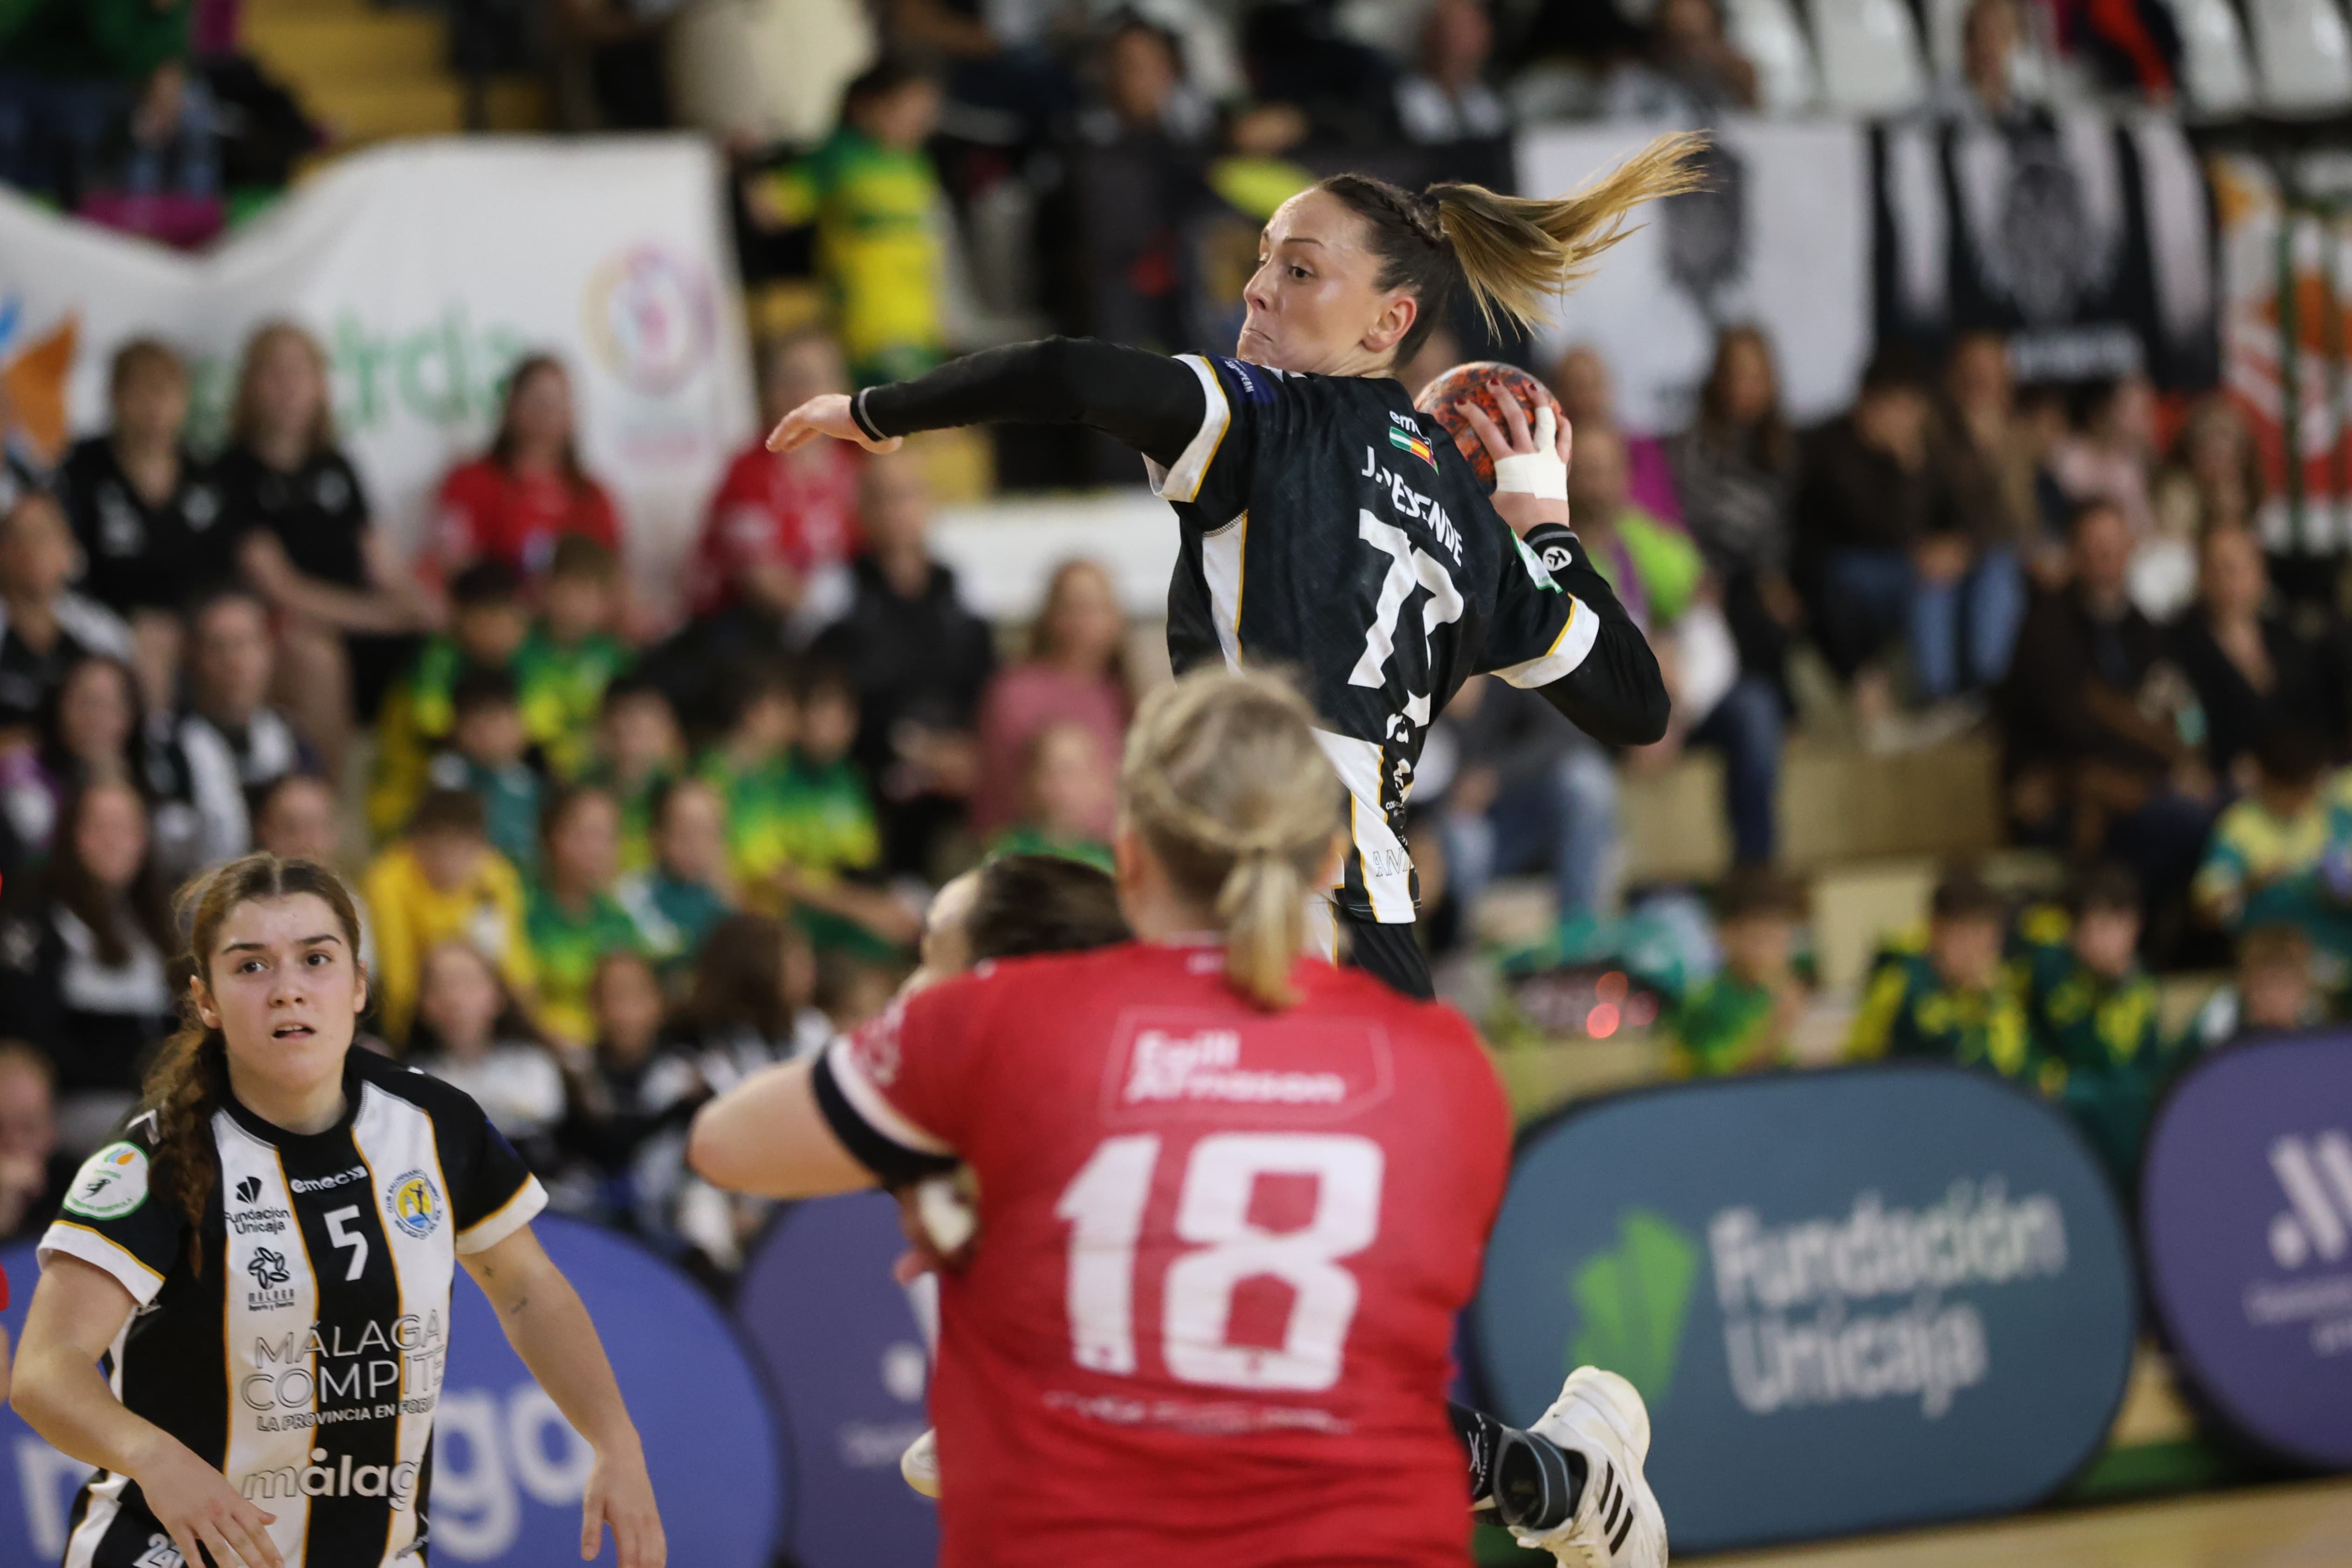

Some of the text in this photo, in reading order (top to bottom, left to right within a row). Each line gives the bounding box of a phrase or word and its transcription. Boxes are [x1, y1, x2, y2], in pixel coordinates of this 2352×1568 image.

[323, 1204, 369, 1281] 5
[1052, 1131, 1386, 1394] 18
[1709, 1174, 2068, 1305] Fundación
[255, 1308, 441, 1369] MÁLAGA
[1723, 1288, 1989, 1419] Unicaja
[240, 1345, 445, 1411] COMPITE
[257, 1415, 280, 1432] LA
[282, 1407, 371, 1431] PROVINCIA
[375, 1404, 398, 1418] EN
